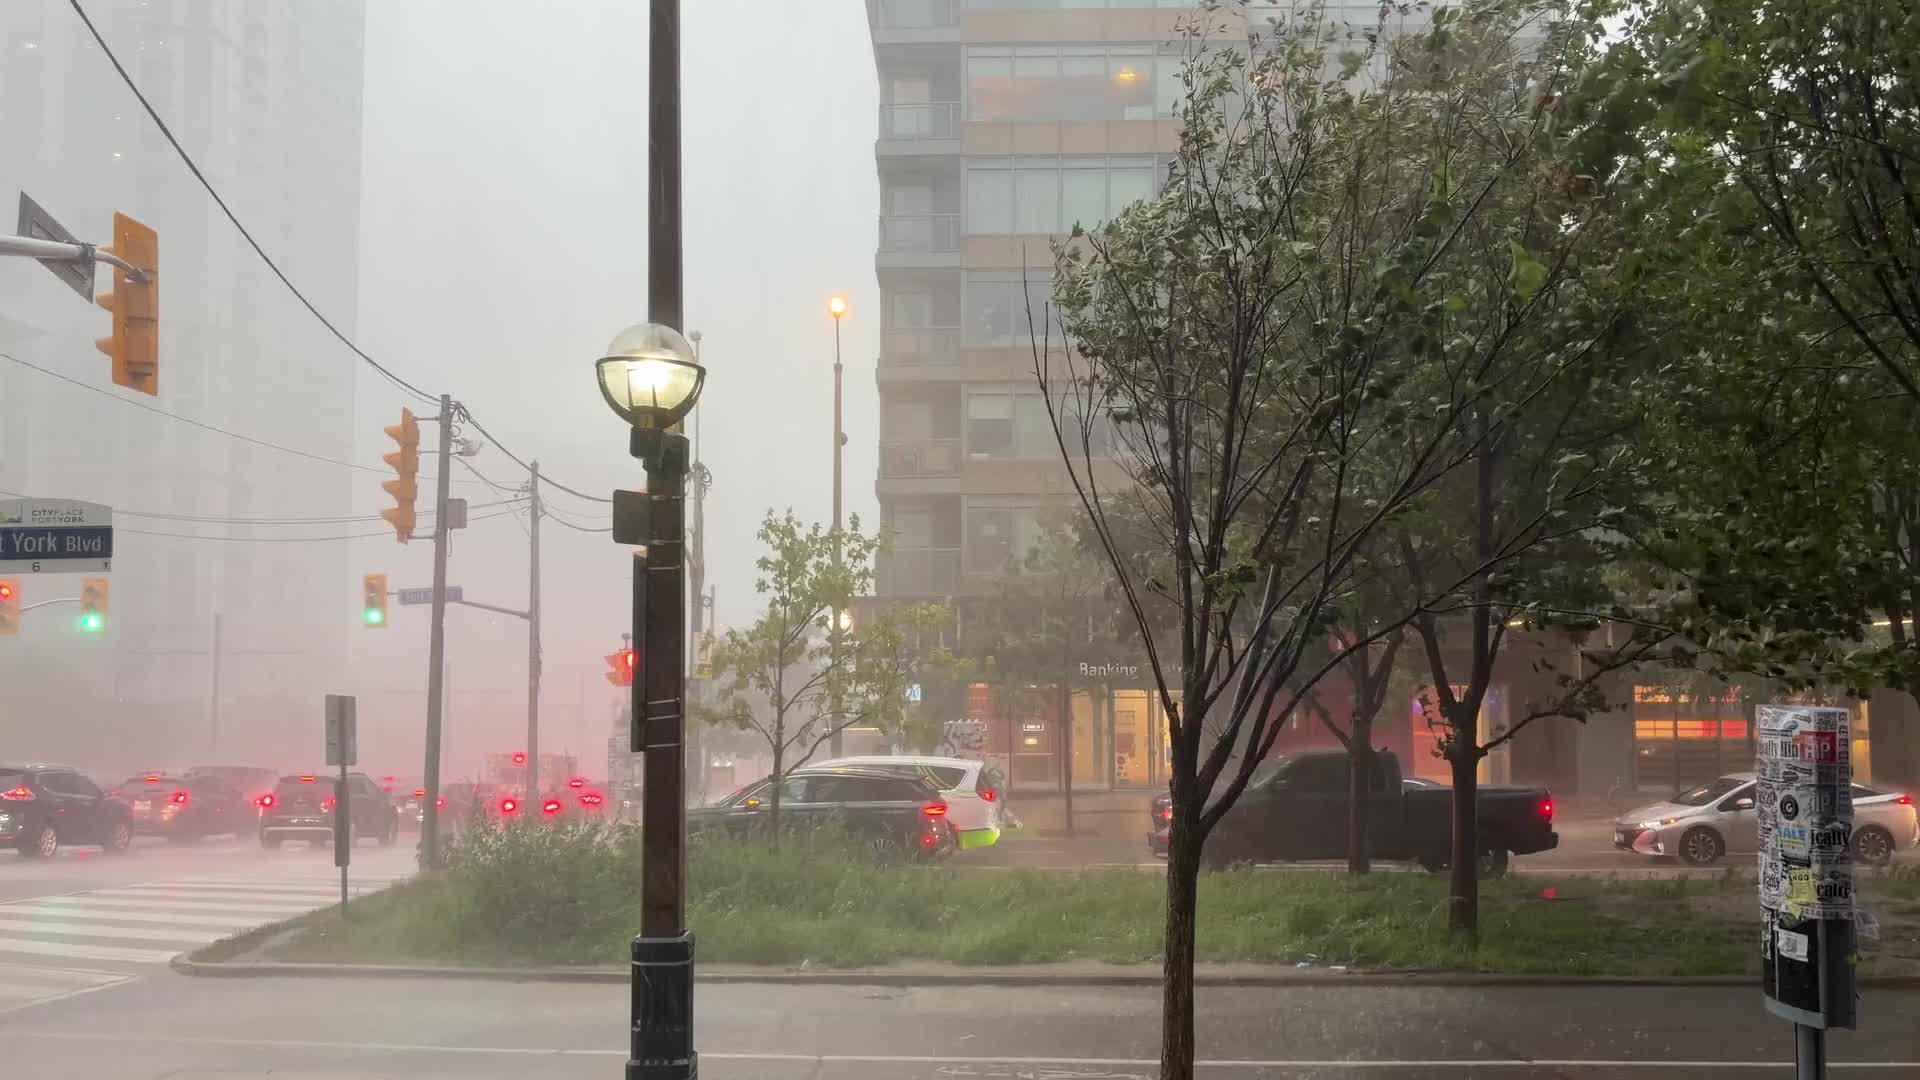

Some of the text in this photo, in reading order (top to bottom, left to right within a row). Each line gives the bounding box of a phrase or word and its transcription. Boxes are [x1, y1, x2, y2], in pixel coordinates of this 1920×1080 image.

[12, 531, 57, 553] York
[66, 535, 102, 553] Blvd
[31, 561, 41, 573] 6
[1079, 661, 1139, 680] Banking
